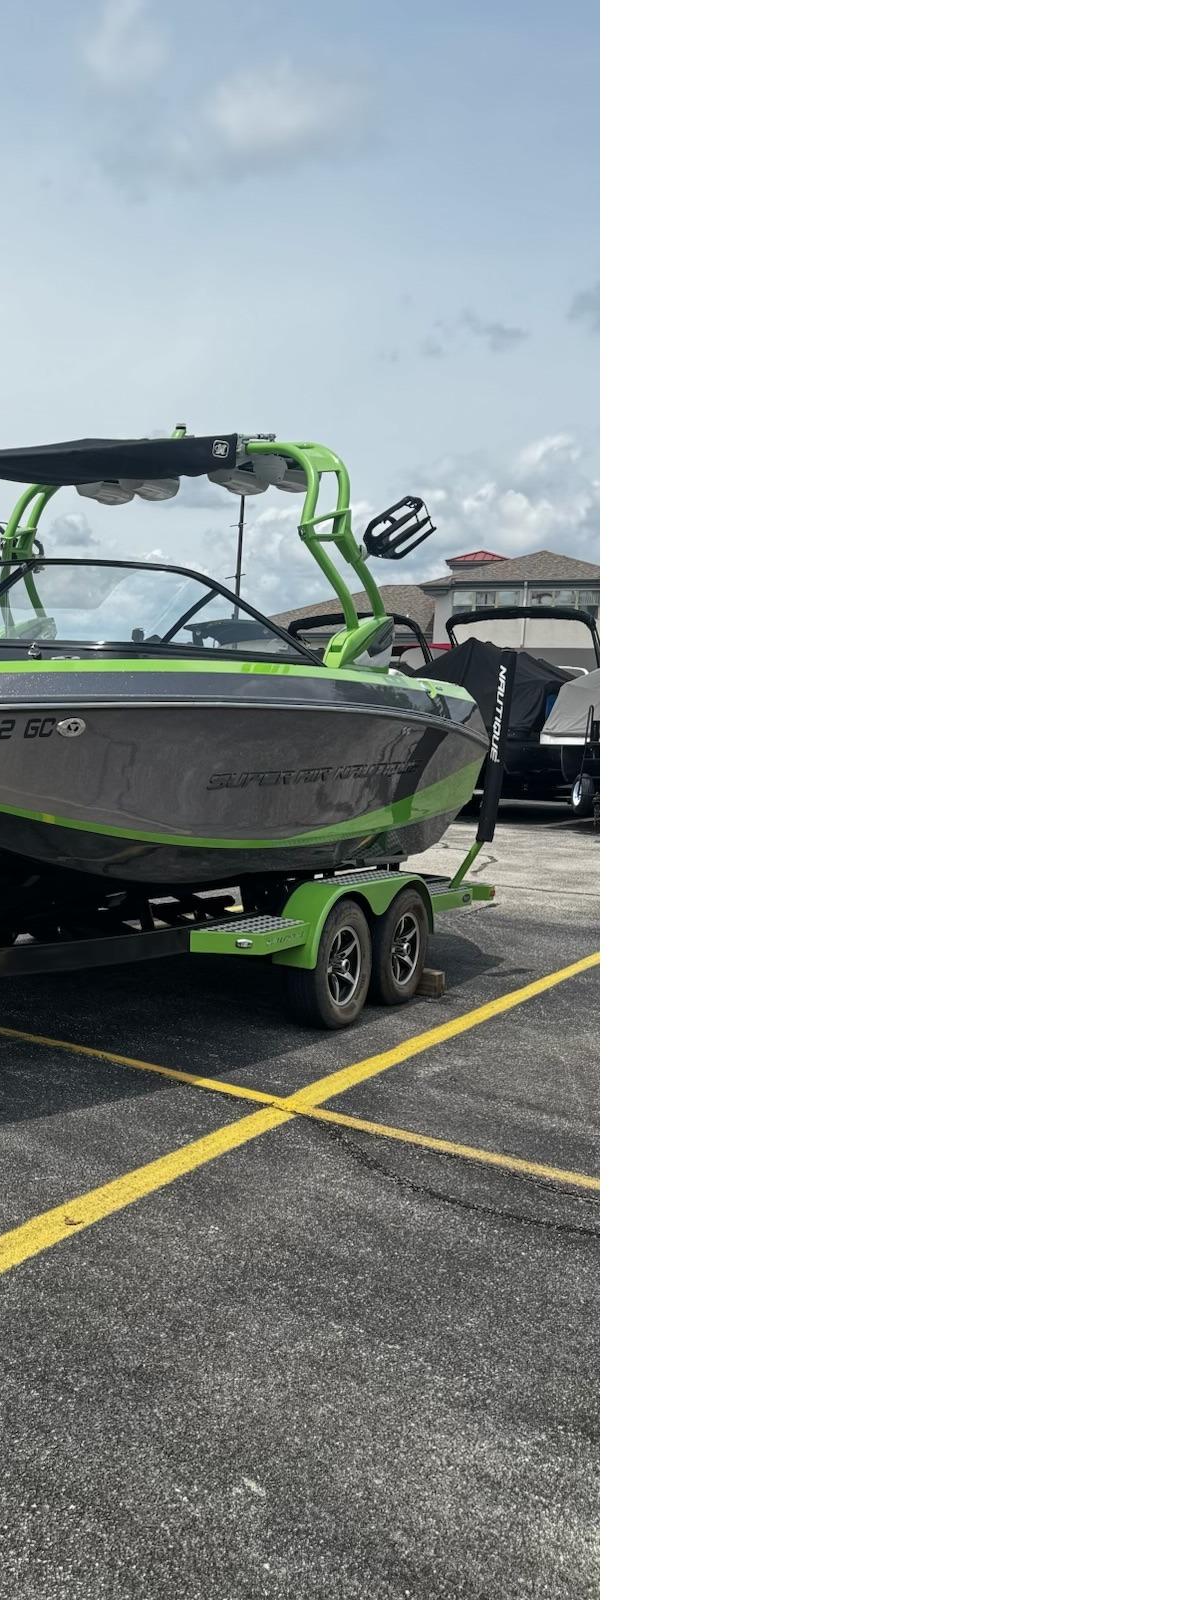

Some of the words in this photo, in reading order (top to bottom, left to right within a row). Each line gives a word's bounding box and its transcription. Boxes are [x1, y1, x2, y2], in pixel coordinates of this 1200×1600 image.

[490, 664, 507, 763] NAUTIQUE
[24, 718, 56, 738] GC
[206, 770, 295, 790] SUPER
